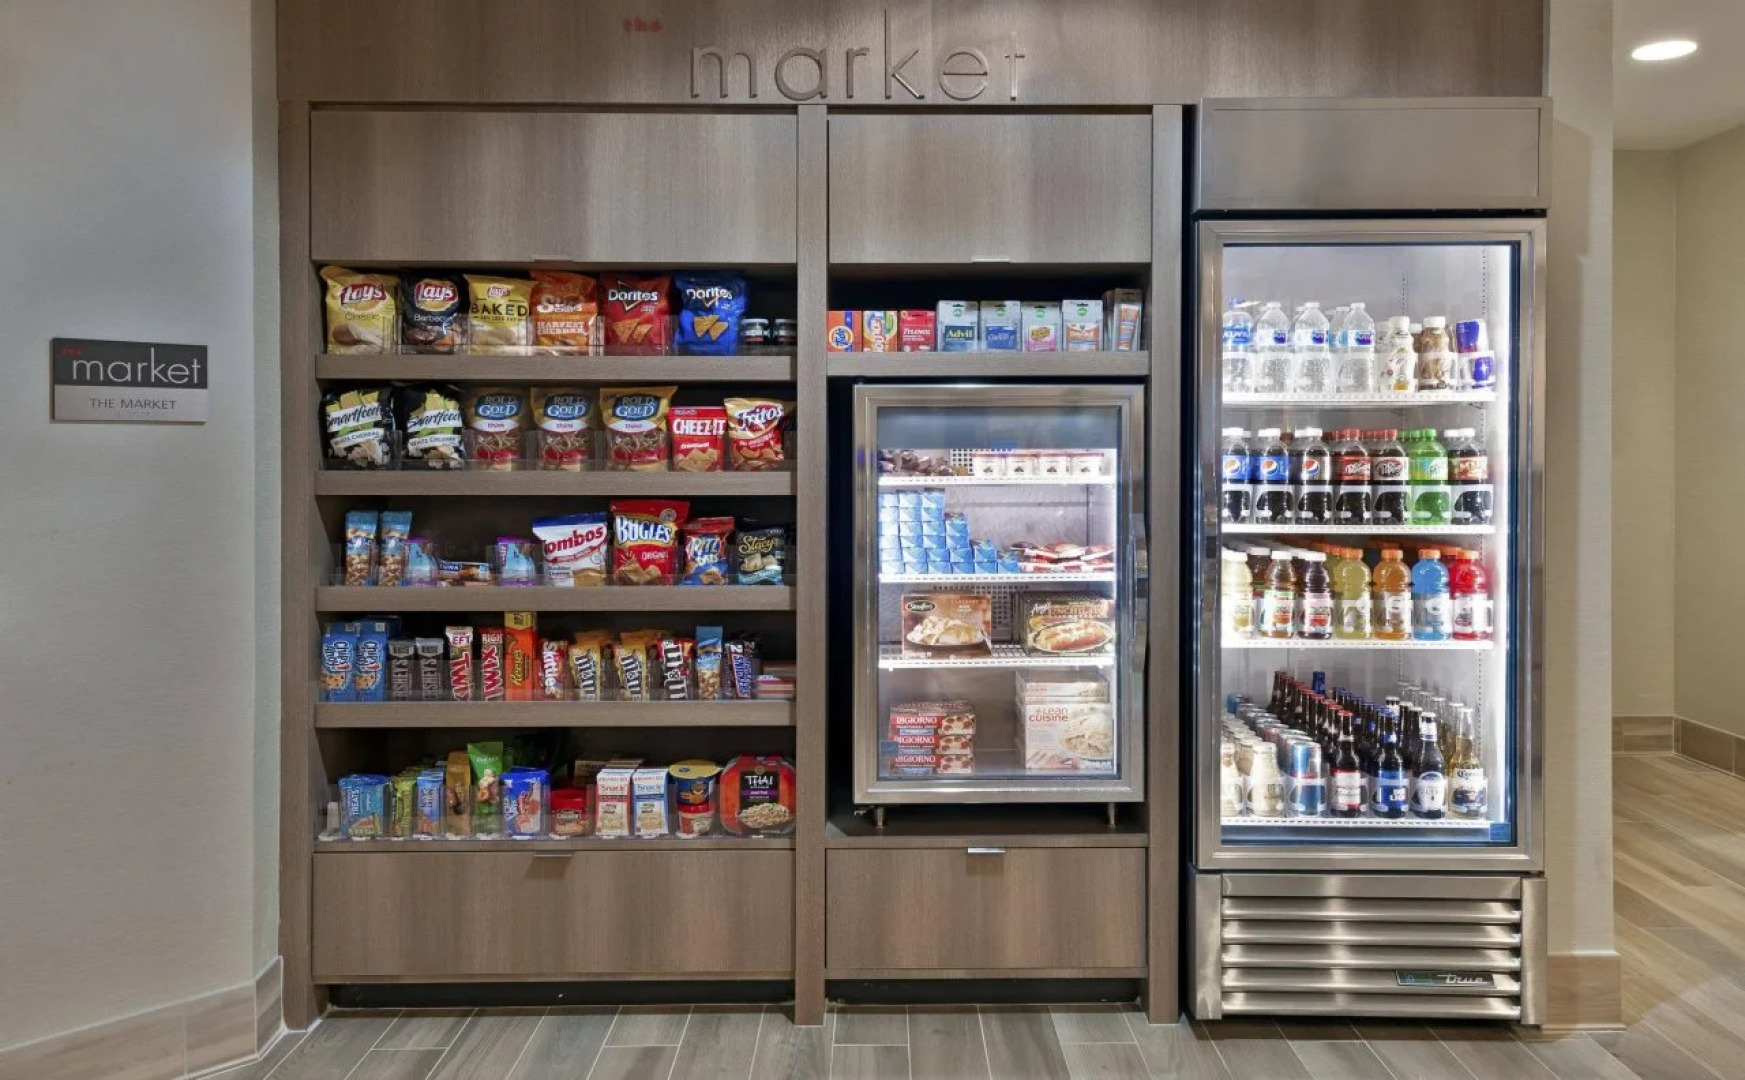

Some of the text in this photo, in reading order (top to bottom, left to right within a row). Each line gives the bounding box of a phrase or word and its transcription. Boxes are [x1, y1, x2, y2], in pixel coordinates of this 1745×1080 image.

[689, 9, 1027, 101] market
[608, 288, 658, 302] Doritos
[471, 302, 529, 317] BAKED
[946, 328, 973, 339] Advil
[72, 346, 202, 384] market
[90, 397, 177, 411] THE MARKET
[478, 403, 517, 416] GOLD
[547, 403, 587, 417] GOLD
[614, 404, 656, 418] GOLD
[735, 403, 785, 430] Fritos
[615, 514, 672, 545] BUGLES
[542, 639, 557, 695] Skittles
[1028, 714, 1069, 722] cuisine
[744, 775, 774, 786] THAI
[351, 789, 361, 817] TREATS
